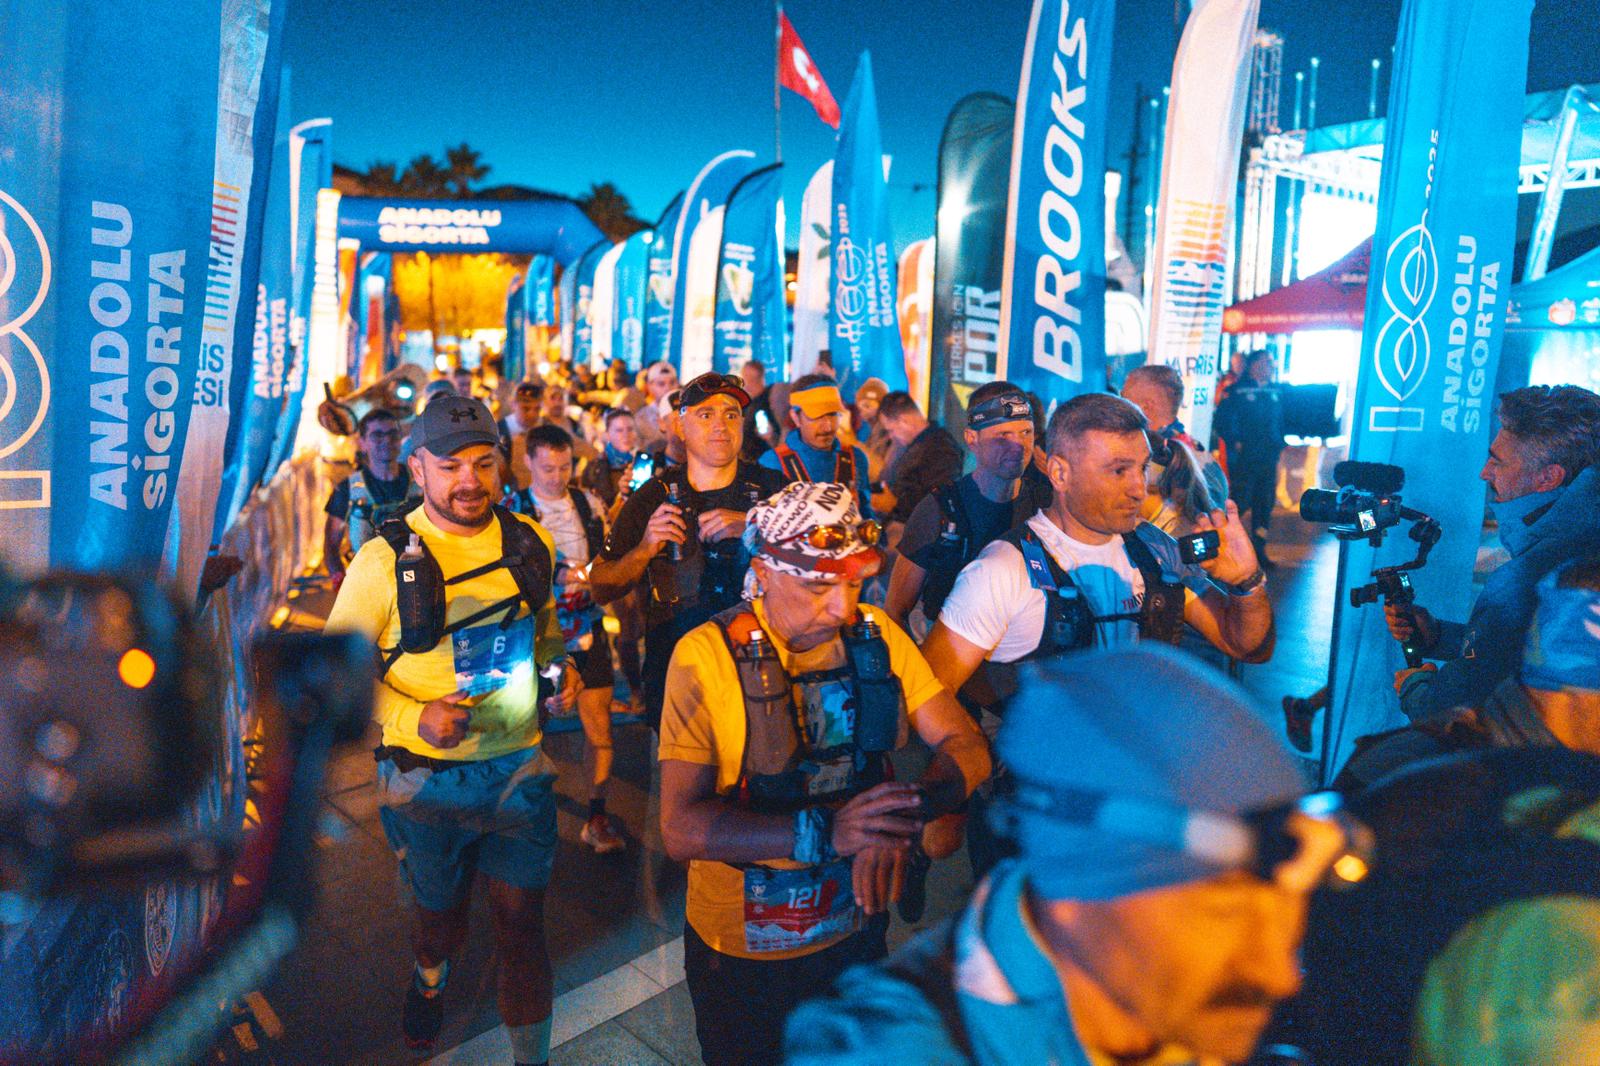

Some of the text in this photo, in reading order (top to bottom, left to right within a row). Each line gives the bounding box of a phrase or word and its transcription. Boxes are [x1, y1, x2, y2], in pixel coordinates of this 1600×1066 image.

[1033, 0, 1087, 383] BROOKS
[89, 201, 133, 510] ANADOLU
[131, 250, 185, 510] SİGORTA
[1441, 235, 1477, 433] ANADOLU
[1457, 261, 1501, 434] SİGORTA
[493, 635, 506, 654] 6
[788, 882, 822, 909] 121
